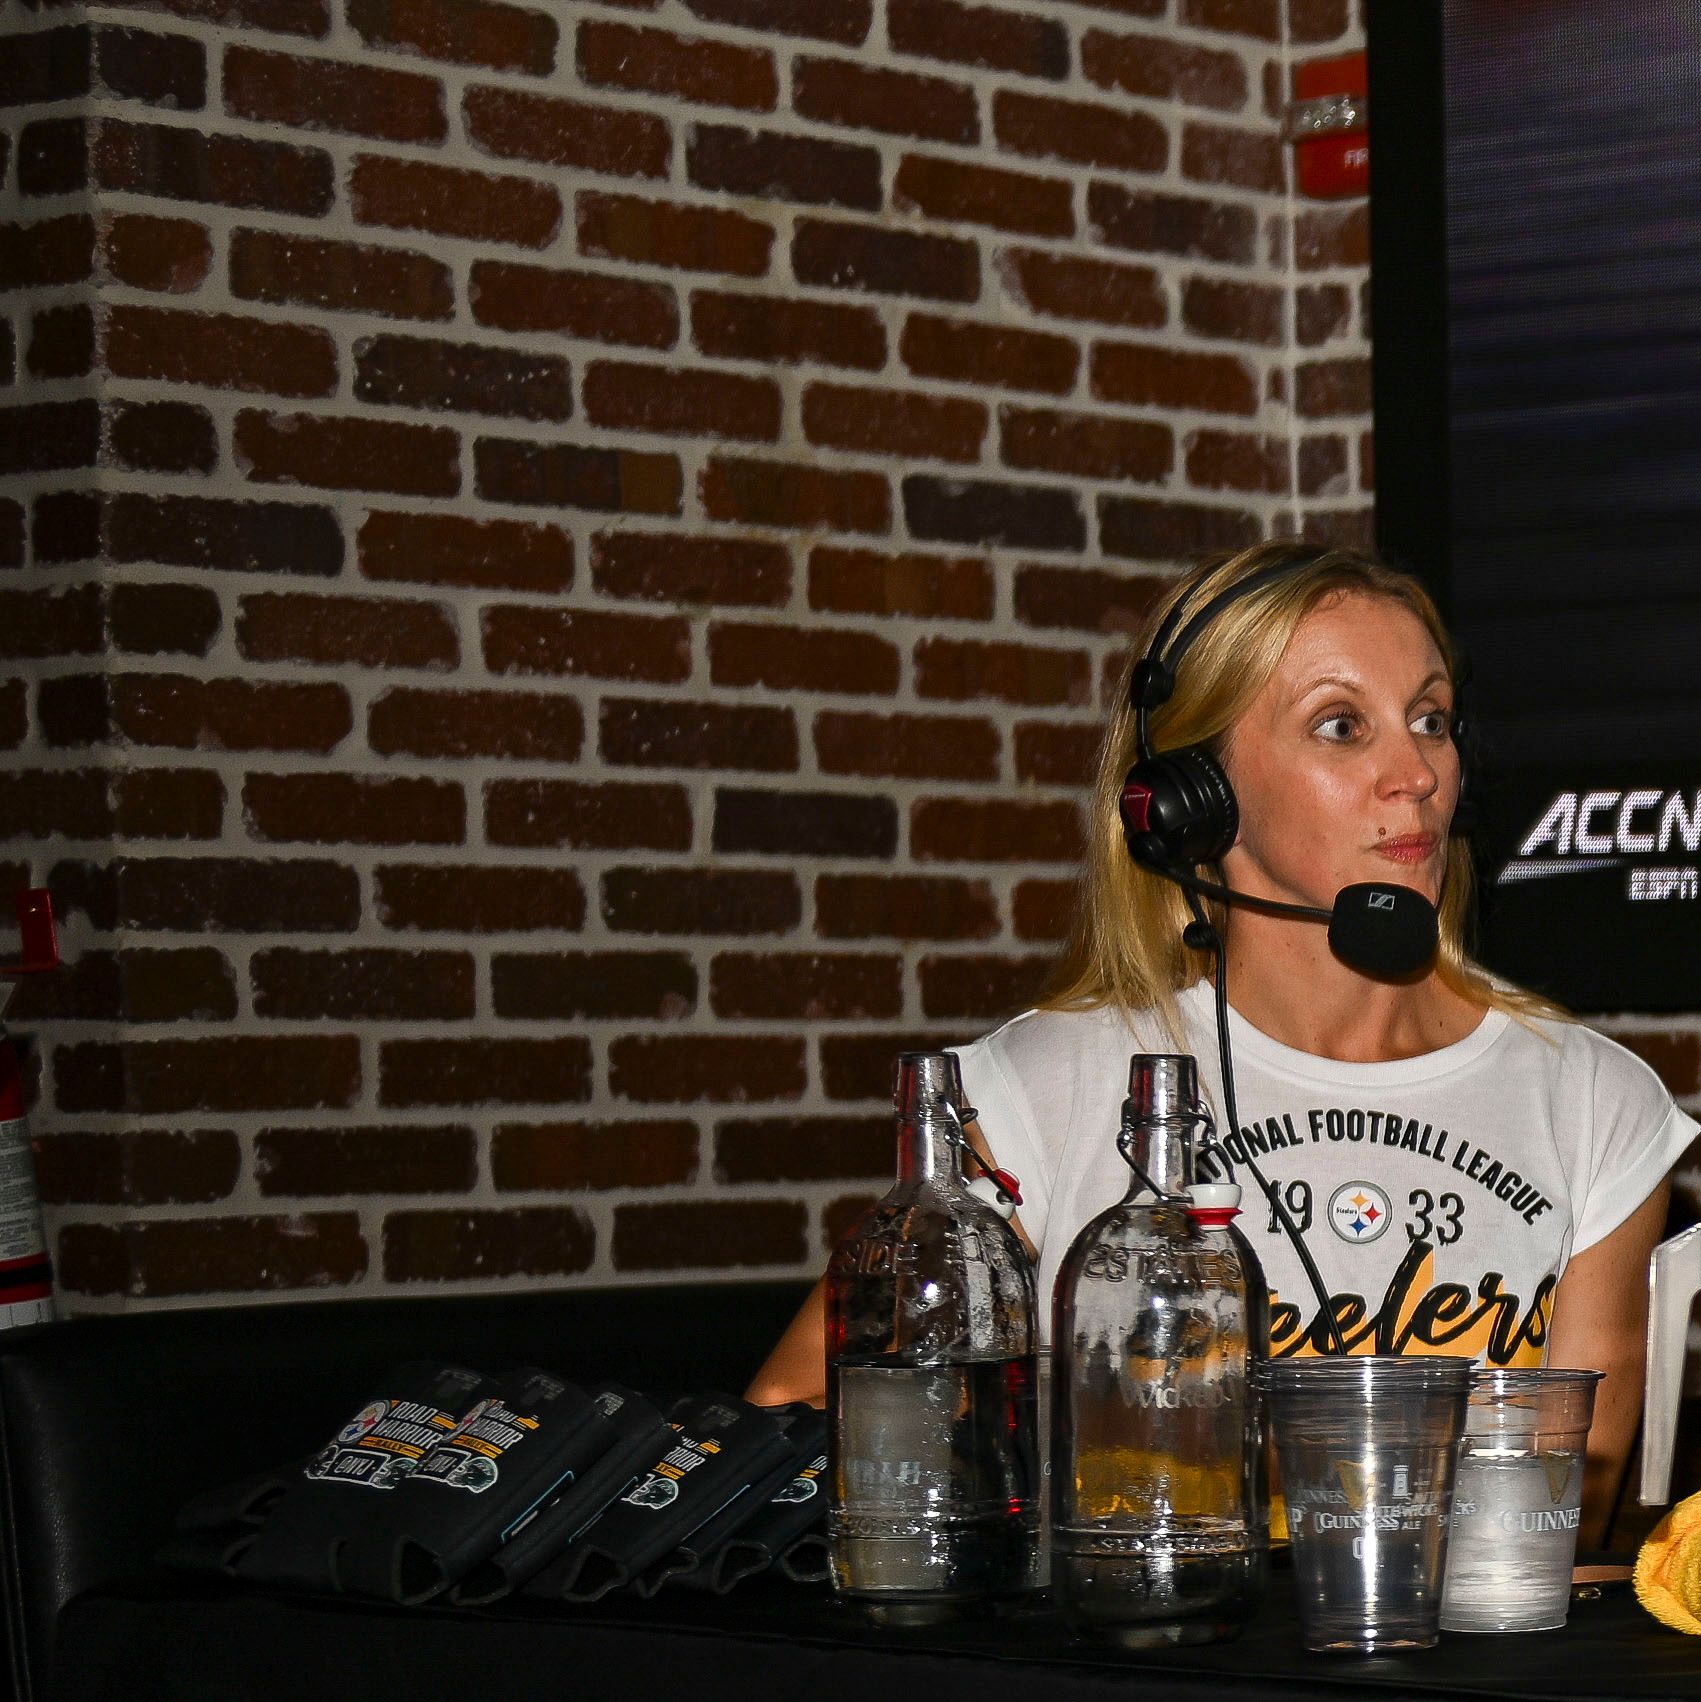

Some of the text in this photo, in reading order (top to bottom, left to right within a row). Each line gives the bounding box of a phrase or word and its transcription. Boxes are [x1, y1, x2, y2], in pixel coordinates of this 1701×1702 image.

[1267, 1179, 1313, 1234] 19
[1307, 1108, 1450, 1164] FOOTBALL
[1451, 1138, 1554, 1226] LEAGUE
[1404, 1187, 1465, 1246] 33
[1270, 1240, 1558, 1365] eelers
